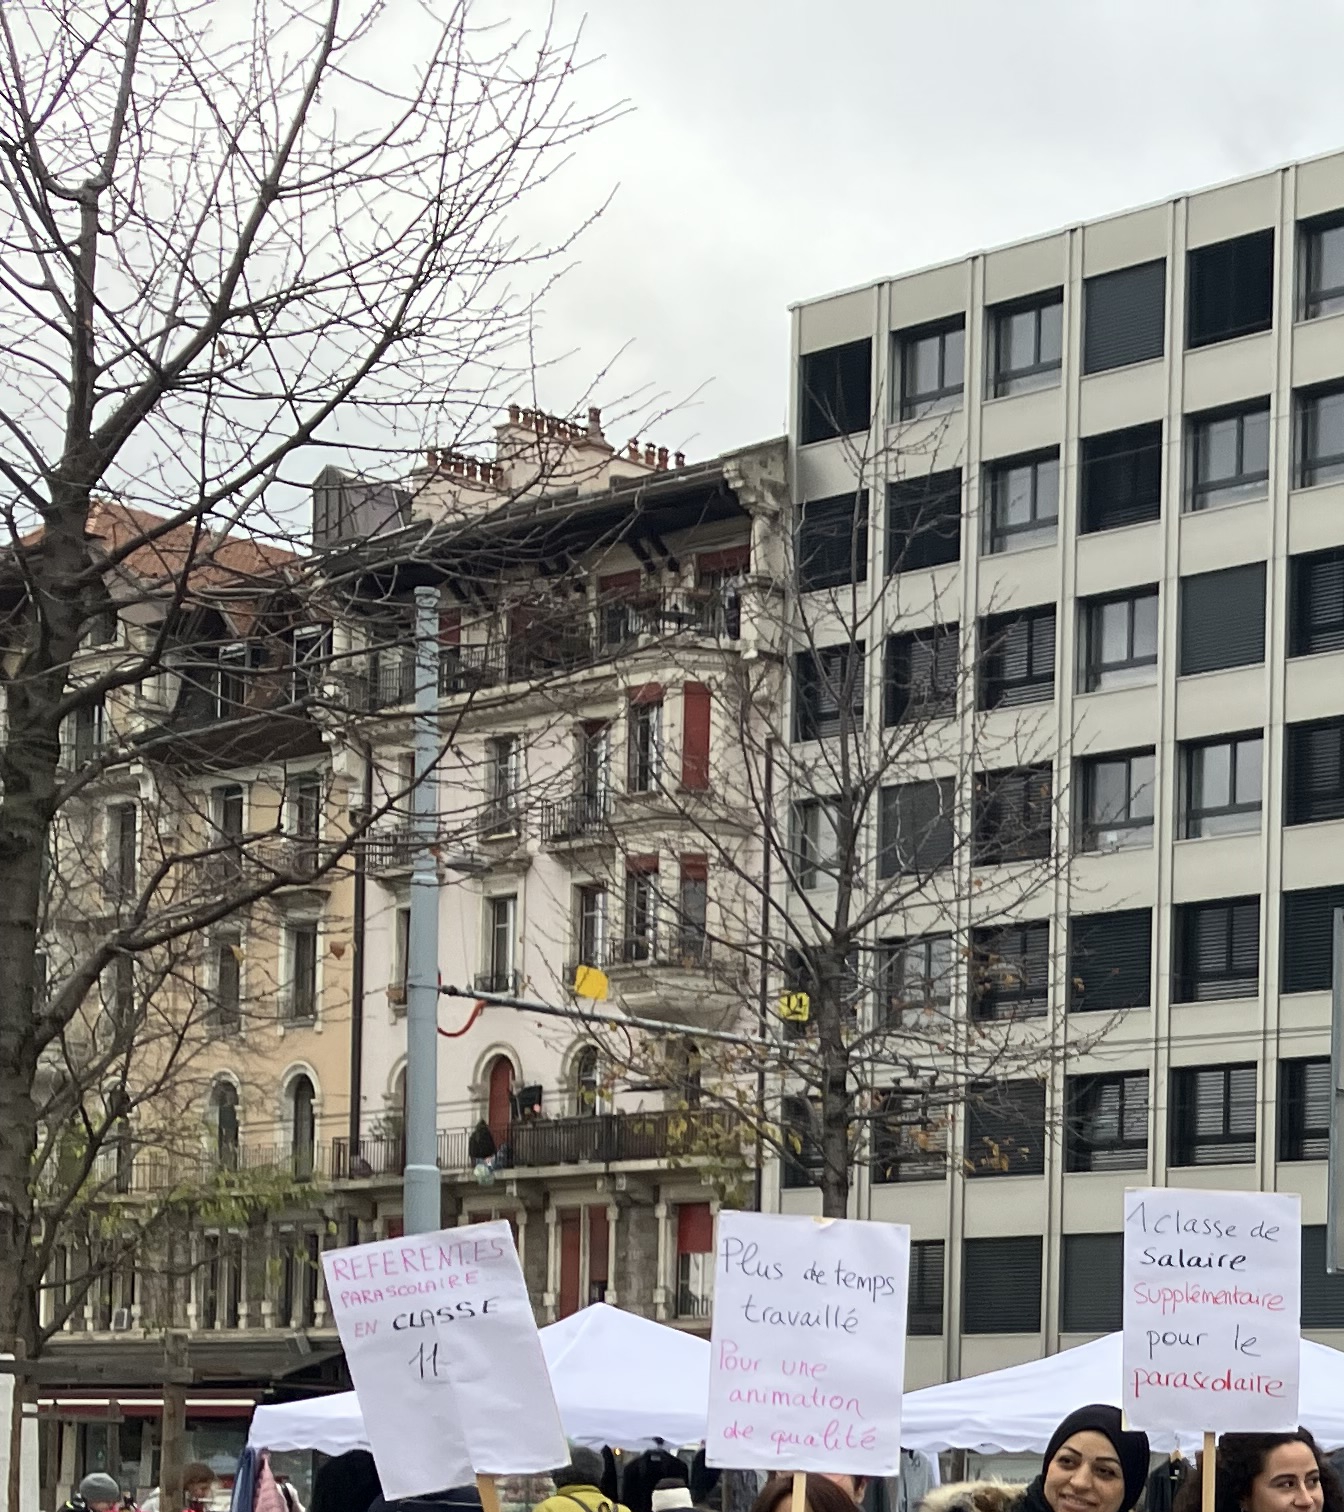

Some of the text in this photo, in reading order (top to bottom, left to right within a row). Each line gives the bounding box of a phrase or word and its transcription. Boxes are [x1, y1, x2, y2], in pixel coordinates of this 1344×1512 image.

[1126, 1201, 1147, 1235] 1
[1250, 1220, 1280, 1242] de
[340, 1270, 479, 1308] PARASCOLAIRE
[720, 1237, 895, 1303] Plus de temps
[354, 1296, 500, 1338] EN CLASSE
[741, 1294, 859, 1333] travaillé
[719, 1339, 828, 1379] Pour une
[1147, 1323, 1261, 1360] pour le
[1131, 1368, 1288, 1399] parascolaire
[729, 1387, 864, 1419] animation
[723, 1420, 876, 1455] de qualité
